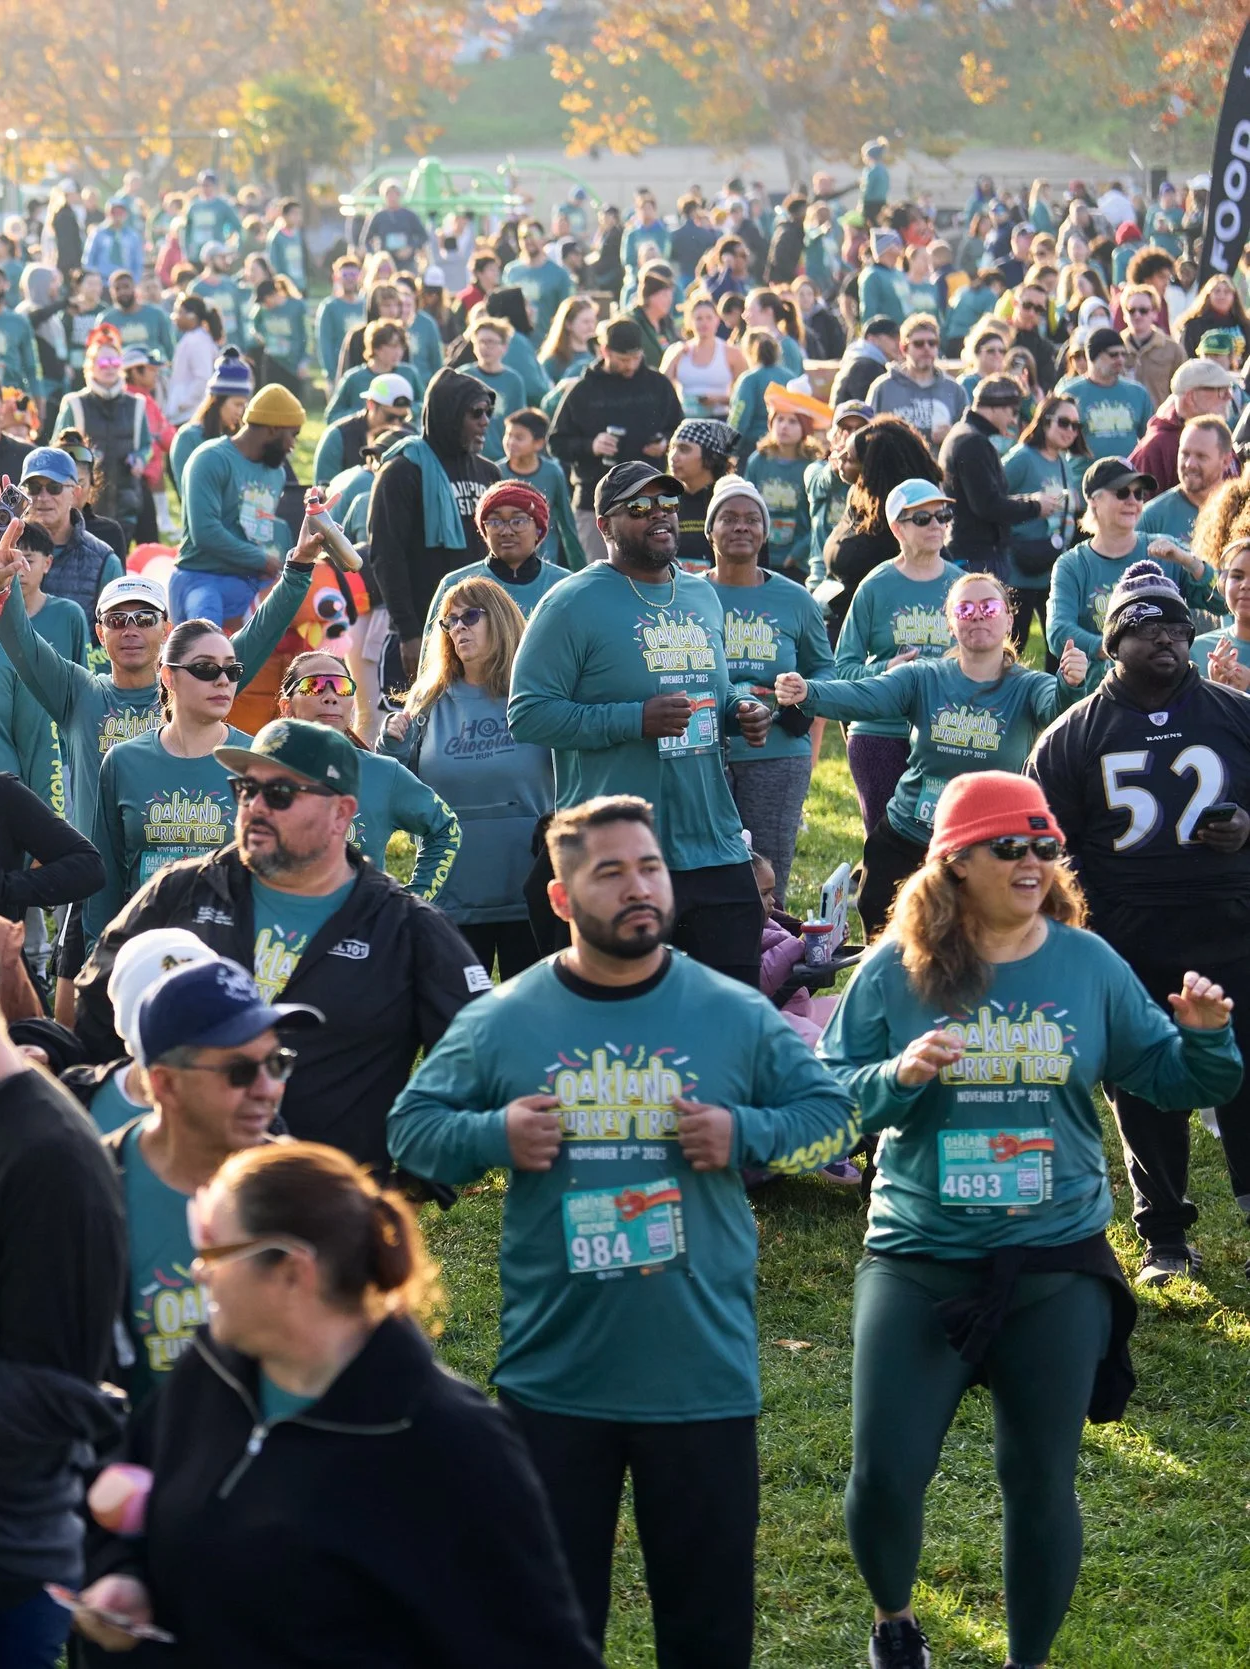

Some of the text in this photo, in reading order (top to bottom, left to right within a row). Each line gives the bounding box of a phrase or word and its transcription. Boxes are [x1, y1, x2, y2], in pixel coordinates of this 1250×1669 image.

[643, 612, 708, 650] OAKLAND
[724, 611, 773, 643] KLAND
[643, 649, 717, 672] TURKEY TROT
[747, 643, 778, 661] TROT
[660, 675, 684, 684] NOVEMBER
[938, 705, 998, 734] OAKLAND
[931, 724, 1001, 751] TURKEY TROT
[1145, 732, 1183, 741] RAVENS
[476, 752, 493, 760] RUN
[150, 791, 222, 825] OAKLAND
[1100, 745, 1228, 852] 52
[144, 824, 226, 843] TURKEY TROT
[554, 1049, 683, 1107] OAKLAND
[1018, 1054, 1073, 1086] TROT
[957, 1090, 1004, 1103] NOVEMBER
[1027, 1090, 1050, 1103] 2025
[635, 1106, 685, 1141] TRO
[942, 1173, 1002, 1199] 4693
[571, 1232, 632, 1270] 984
